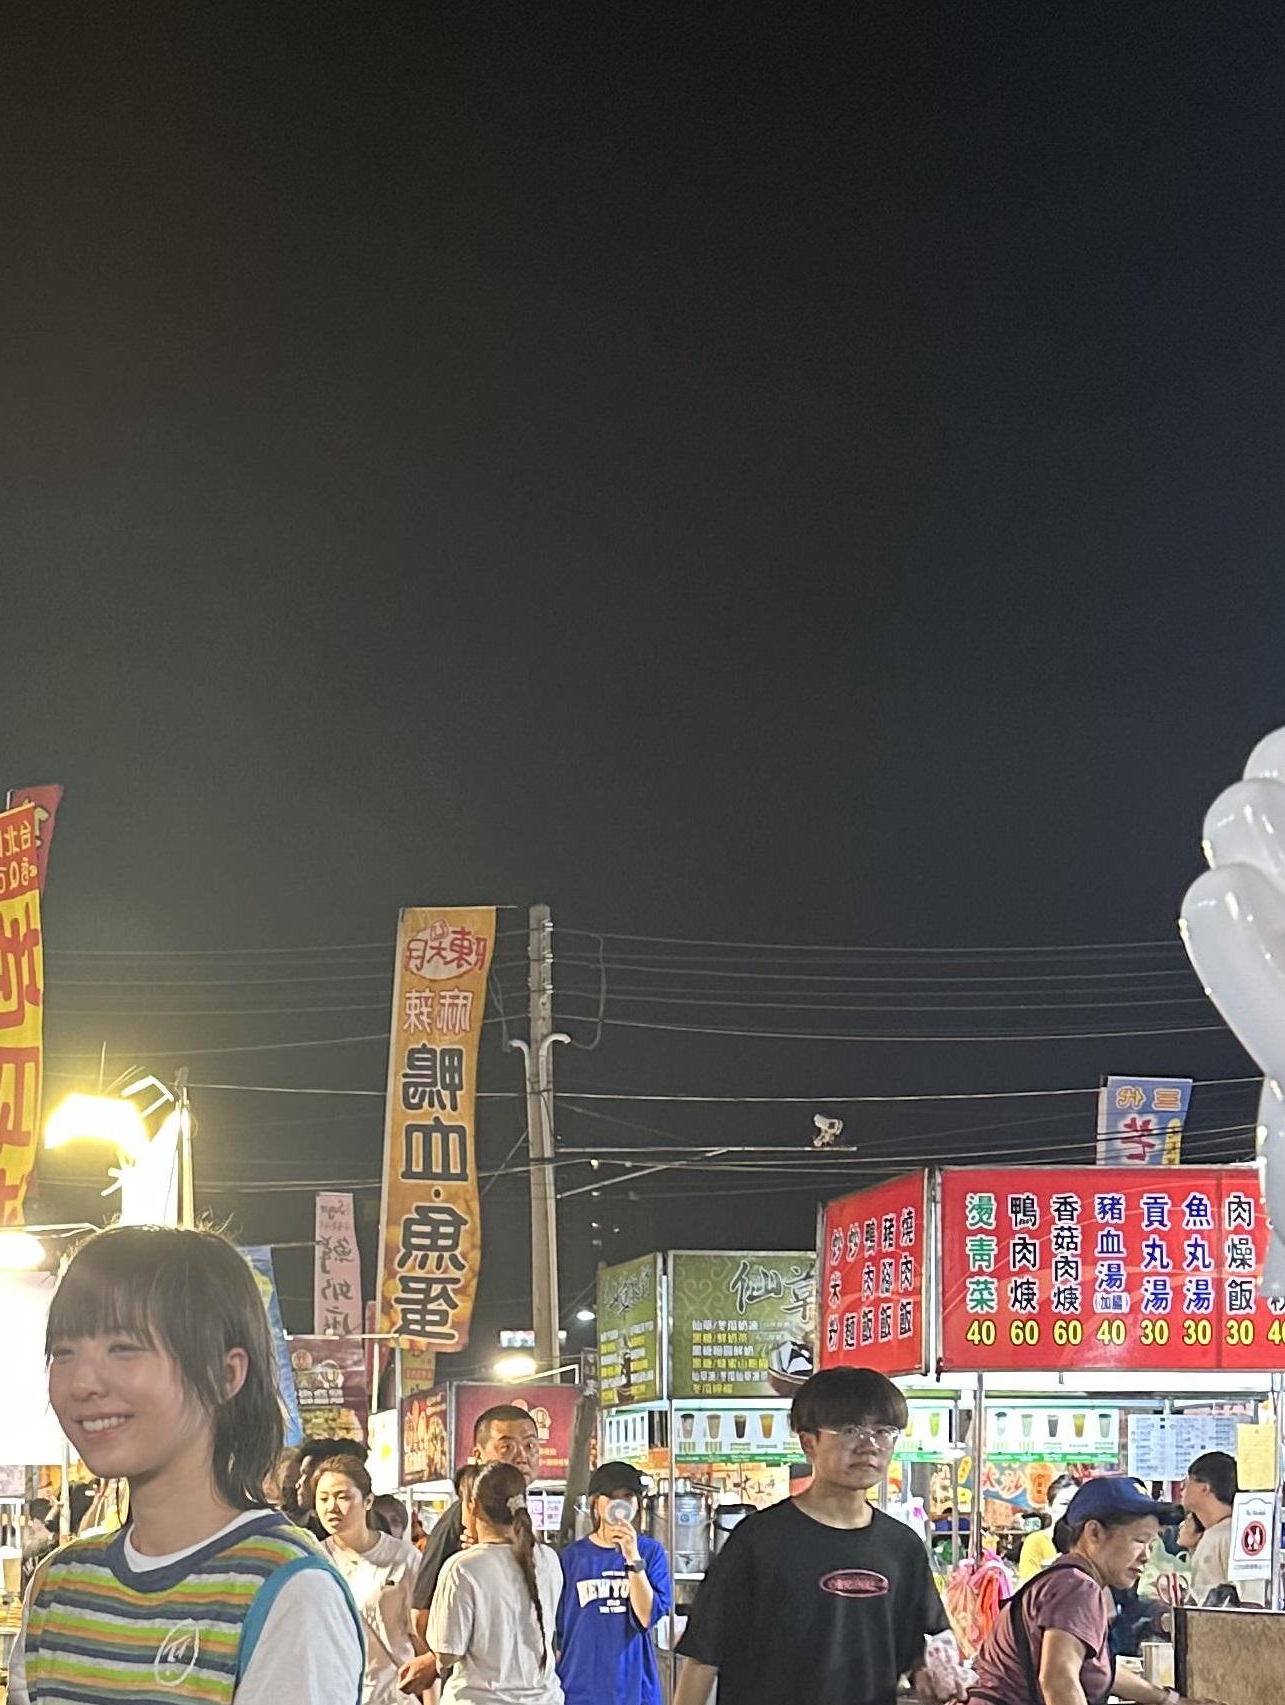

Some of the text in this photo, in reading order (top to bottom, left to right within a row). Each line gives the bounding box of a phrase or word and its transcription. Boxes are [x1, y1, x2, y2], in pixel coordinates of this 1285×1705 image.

[967, 1194, 996, 1311] 燙青菜
[1142, 1195, 1170, 1311] 貢丸湯
[1184, 1194, 1212, 1311] 魚丸湯
[1227, 1195, 1253, 1312] 肉燥飯
[898, 1208, 914, 1338] 燒肉飯
[966, 1319, 996, 1346] 40
[1010, 1319, 1040, 1346] 60
[1053, 1319, 1083, 1346] 60
[1097, 1319, 1127, 1346] 40
[1140, 1319, 1169, 1346] 30
[1183, 1319, 1212, 1346] 30
[1225, 1319, 1254, 1346] 30
